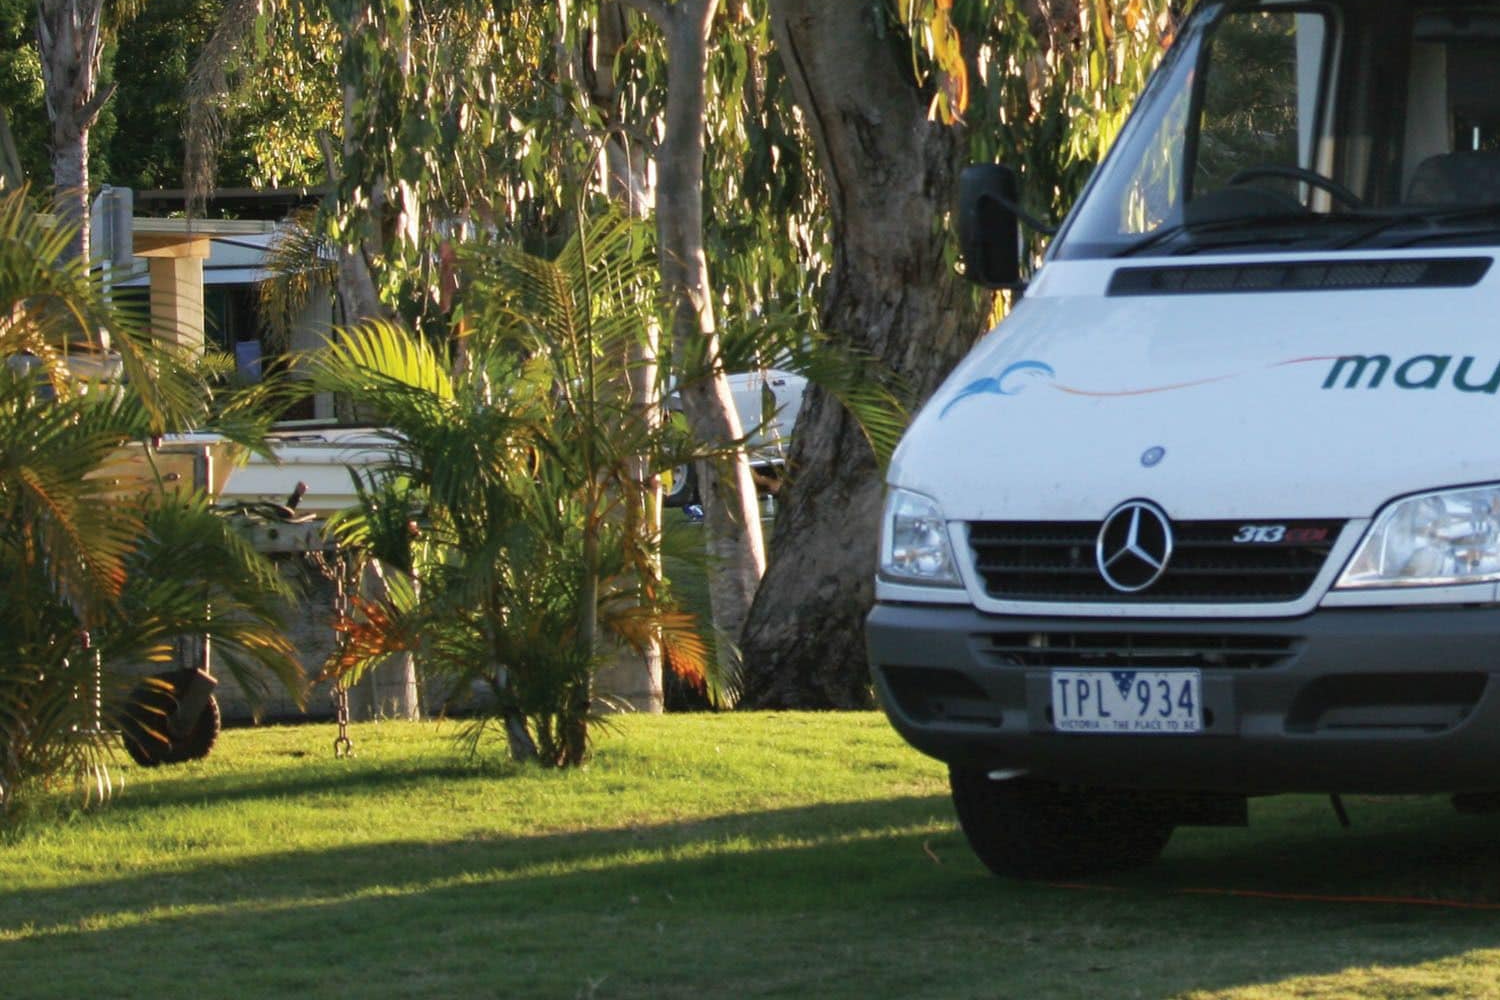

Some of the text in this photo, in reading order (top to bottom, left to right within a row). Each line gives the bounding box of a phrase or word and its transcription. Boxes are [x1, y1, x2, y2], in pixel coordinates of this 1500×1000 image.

[1233, 525, 1286, 543] 313
[1058, 678, 1194, 718] TPL 934
